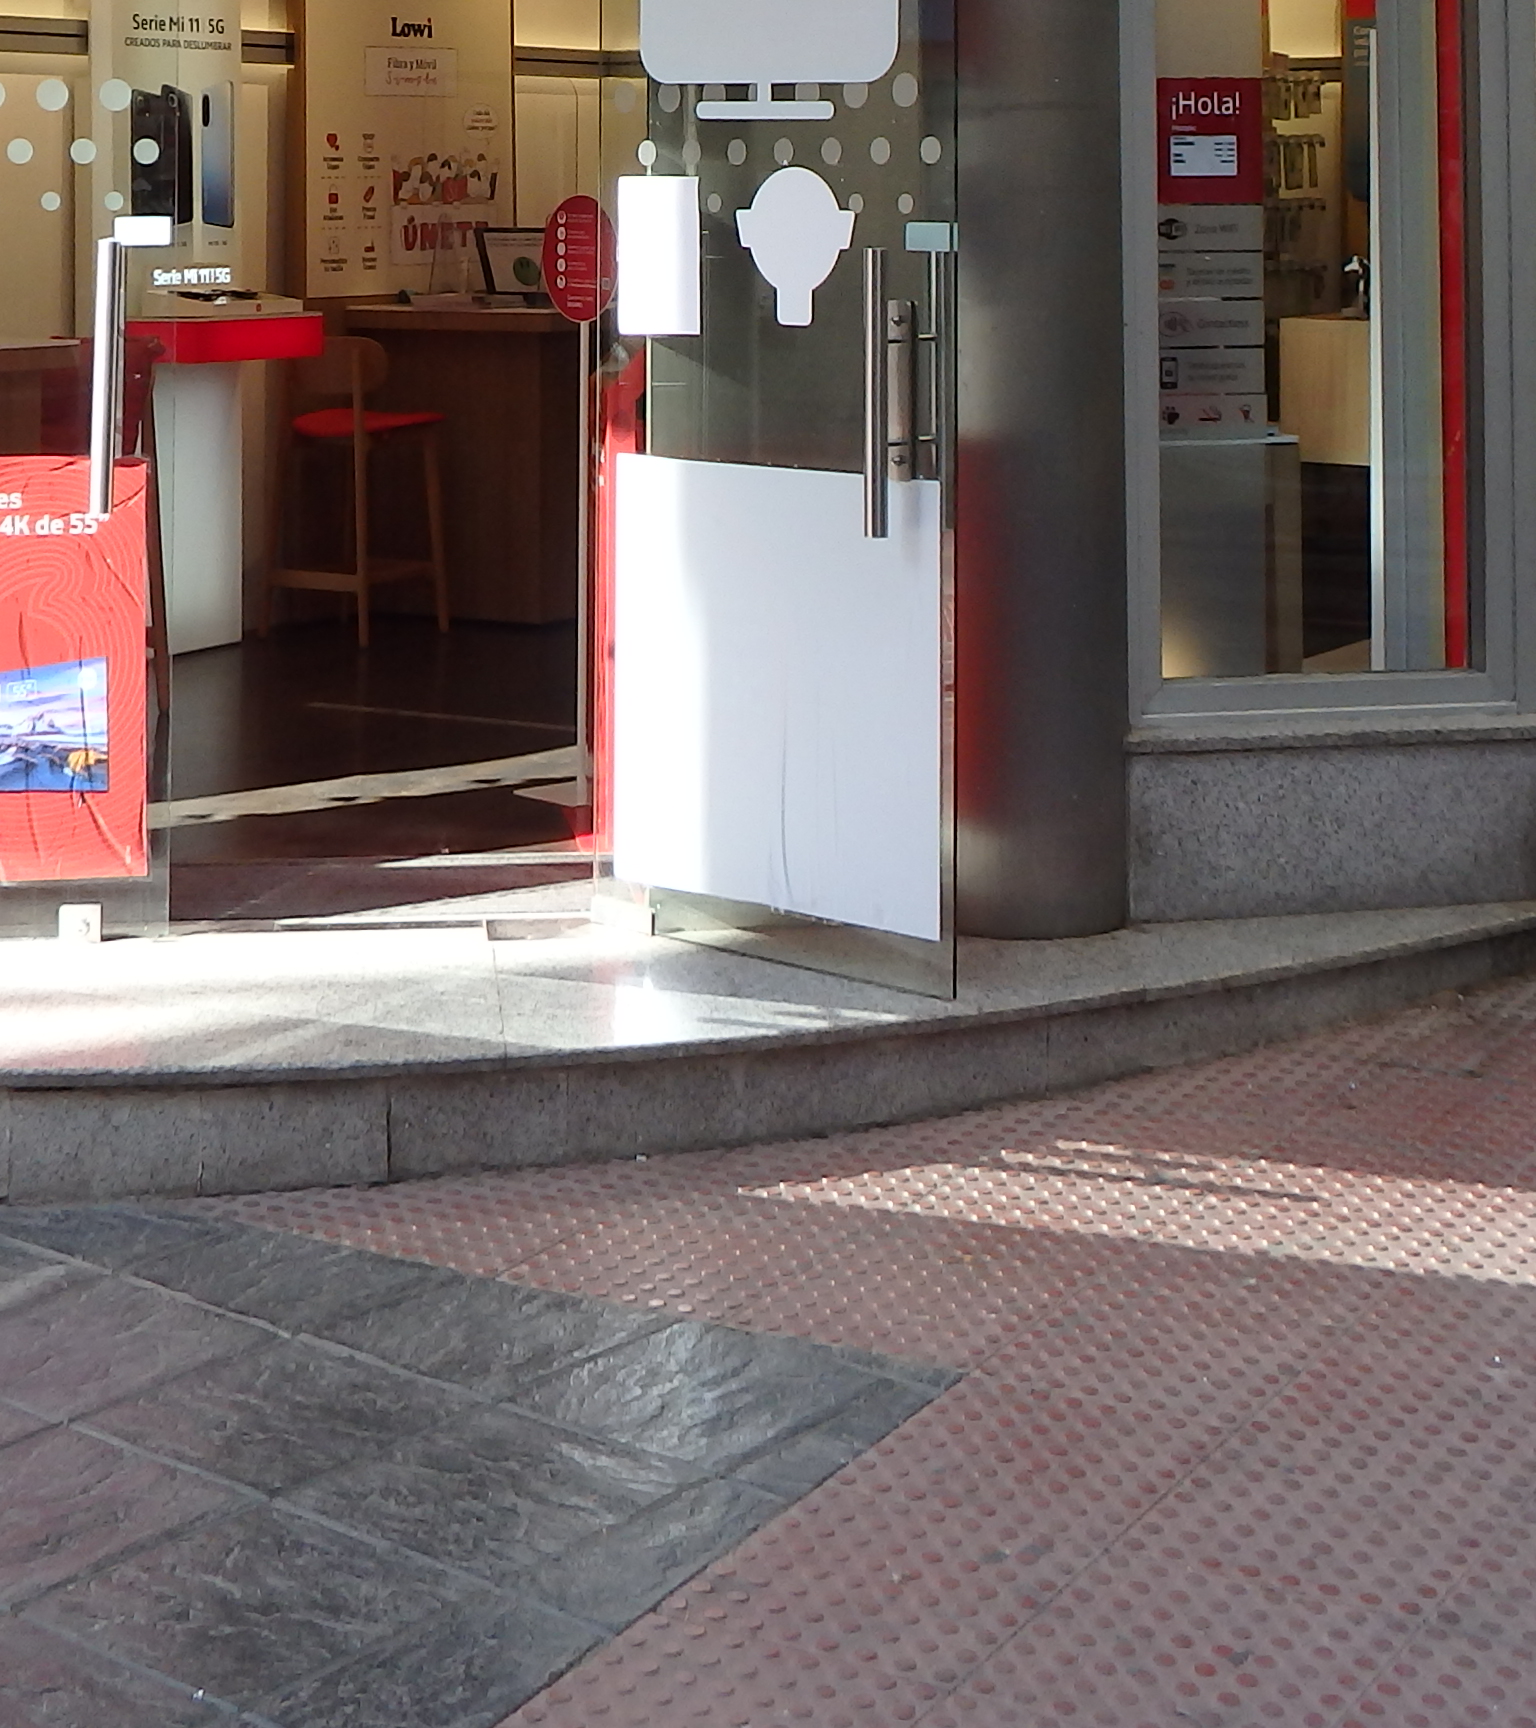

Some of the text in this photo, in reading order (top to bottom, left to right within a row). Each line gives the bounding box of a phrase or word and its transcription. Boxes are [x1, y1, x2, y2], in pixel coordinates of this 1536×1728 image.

[132, 13, 225, 34] Serie Mi 11 5G
[391, 17, 433, 38] Lowi
[124, 37, 232, 51] CREADOS PARA DESLUMBRAR
[1171, 91, 1240, 120] ¡Hola!
[152, 268, 181, 286] Serie
[35, 513, 64, 535] de
